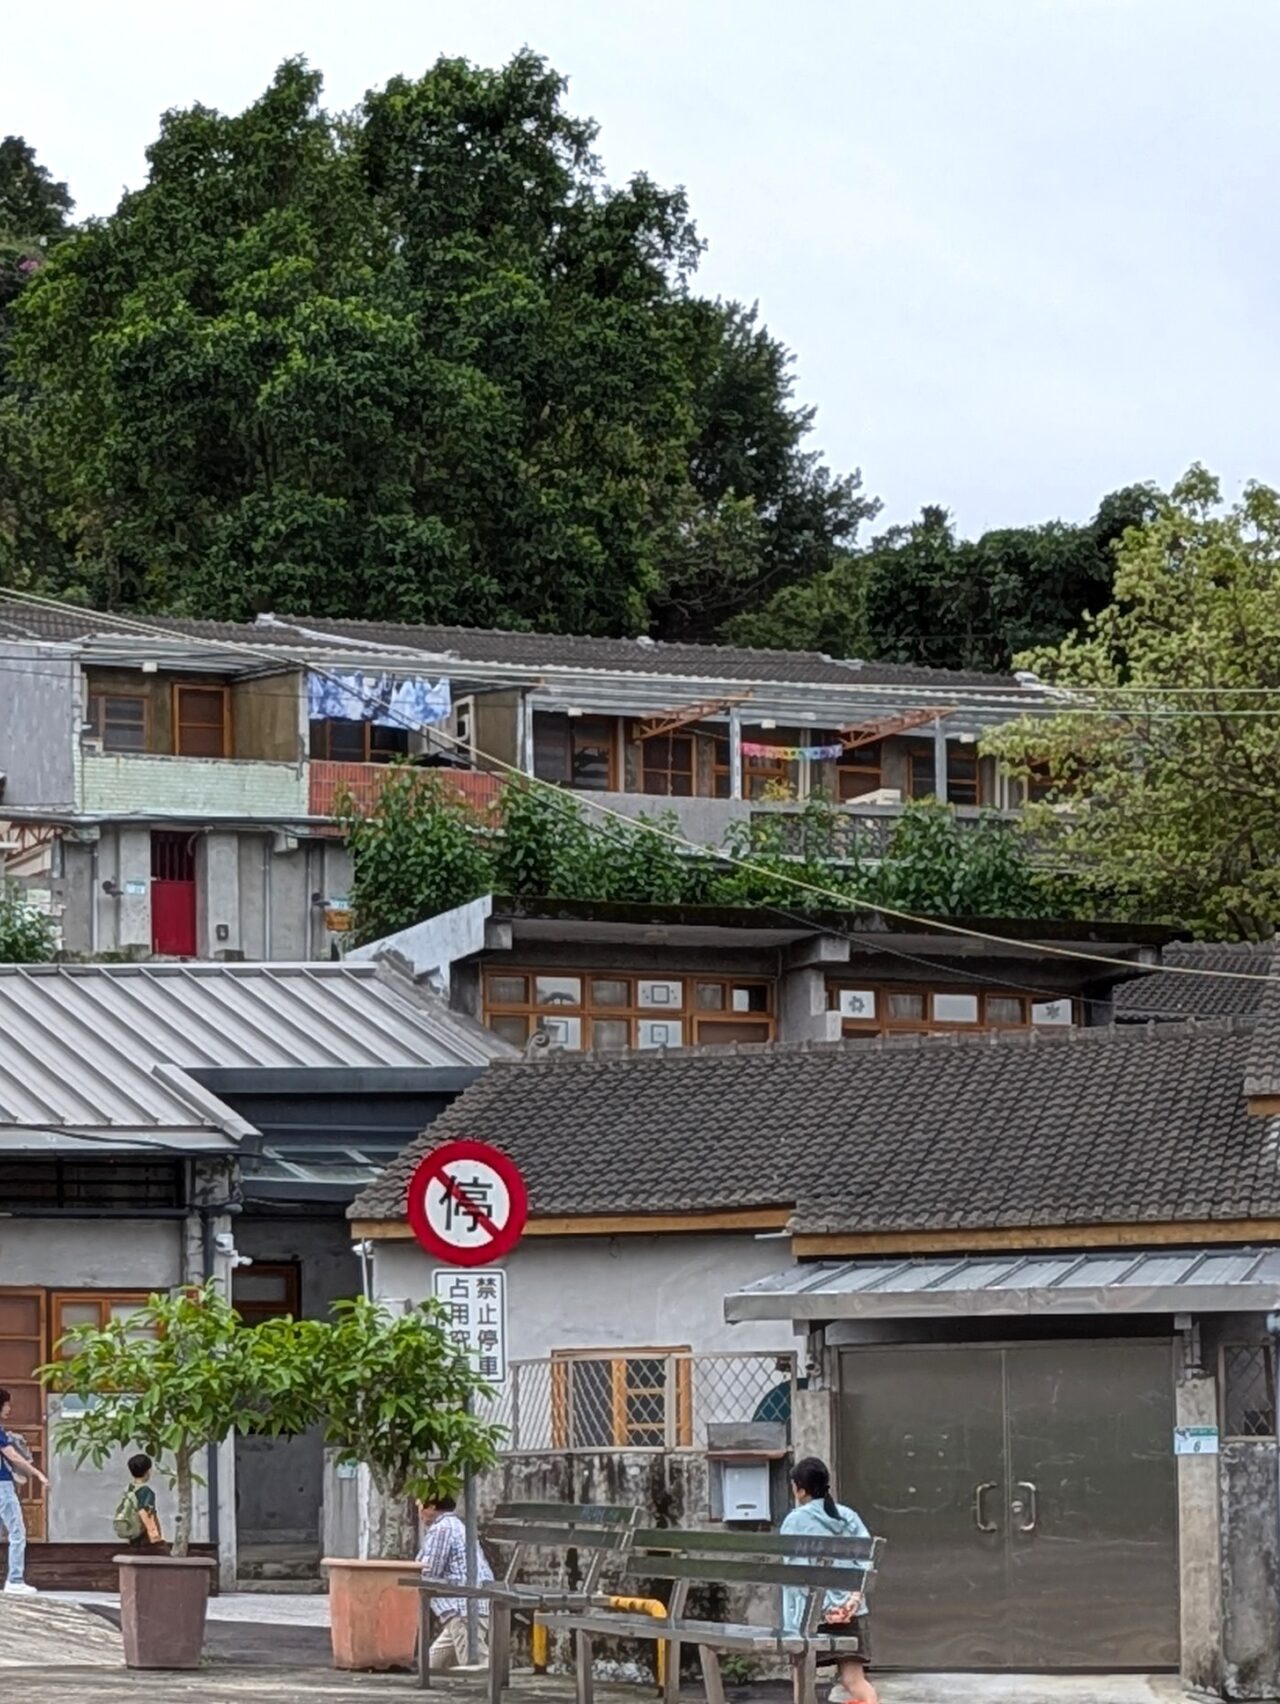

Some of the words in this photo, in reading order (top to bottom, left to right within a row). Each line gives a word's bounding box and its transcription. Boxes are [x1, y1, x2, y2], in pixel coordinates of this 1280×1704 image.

[439, 1175, 494, 1232] 停
[476, 1277, 499, 1376] 禁止停車
